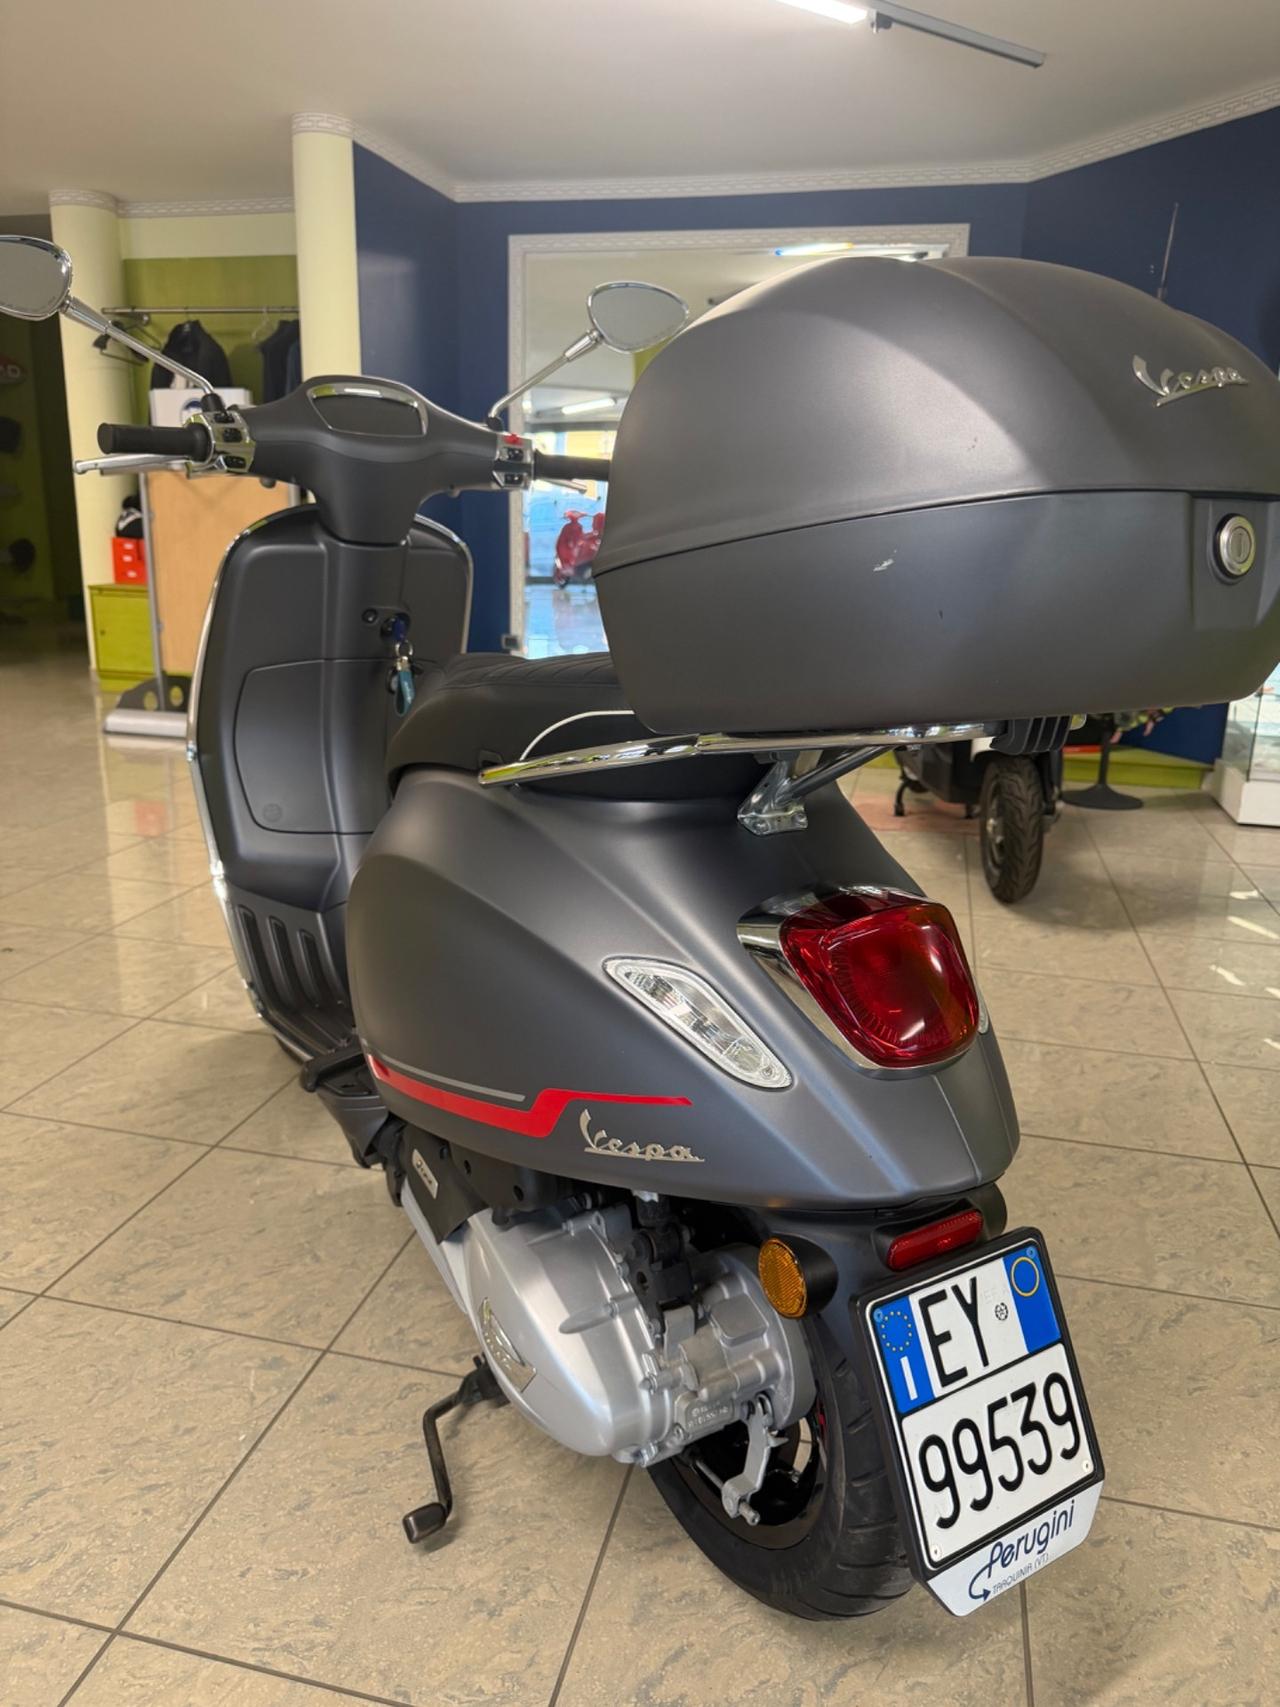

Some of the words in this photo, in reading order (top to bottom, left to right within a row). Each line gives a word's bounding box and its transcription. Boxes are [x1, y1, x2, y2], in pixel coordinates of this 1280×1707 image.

[1132, 354, 1248, 406] Vespa
[579, 1108, 705, 1162] Vespa
[918, 1276, 990, 1387] EY
[918, 1372, 1081, 1529] 99539
[983, 1498, 1075, 1580] Perugini
